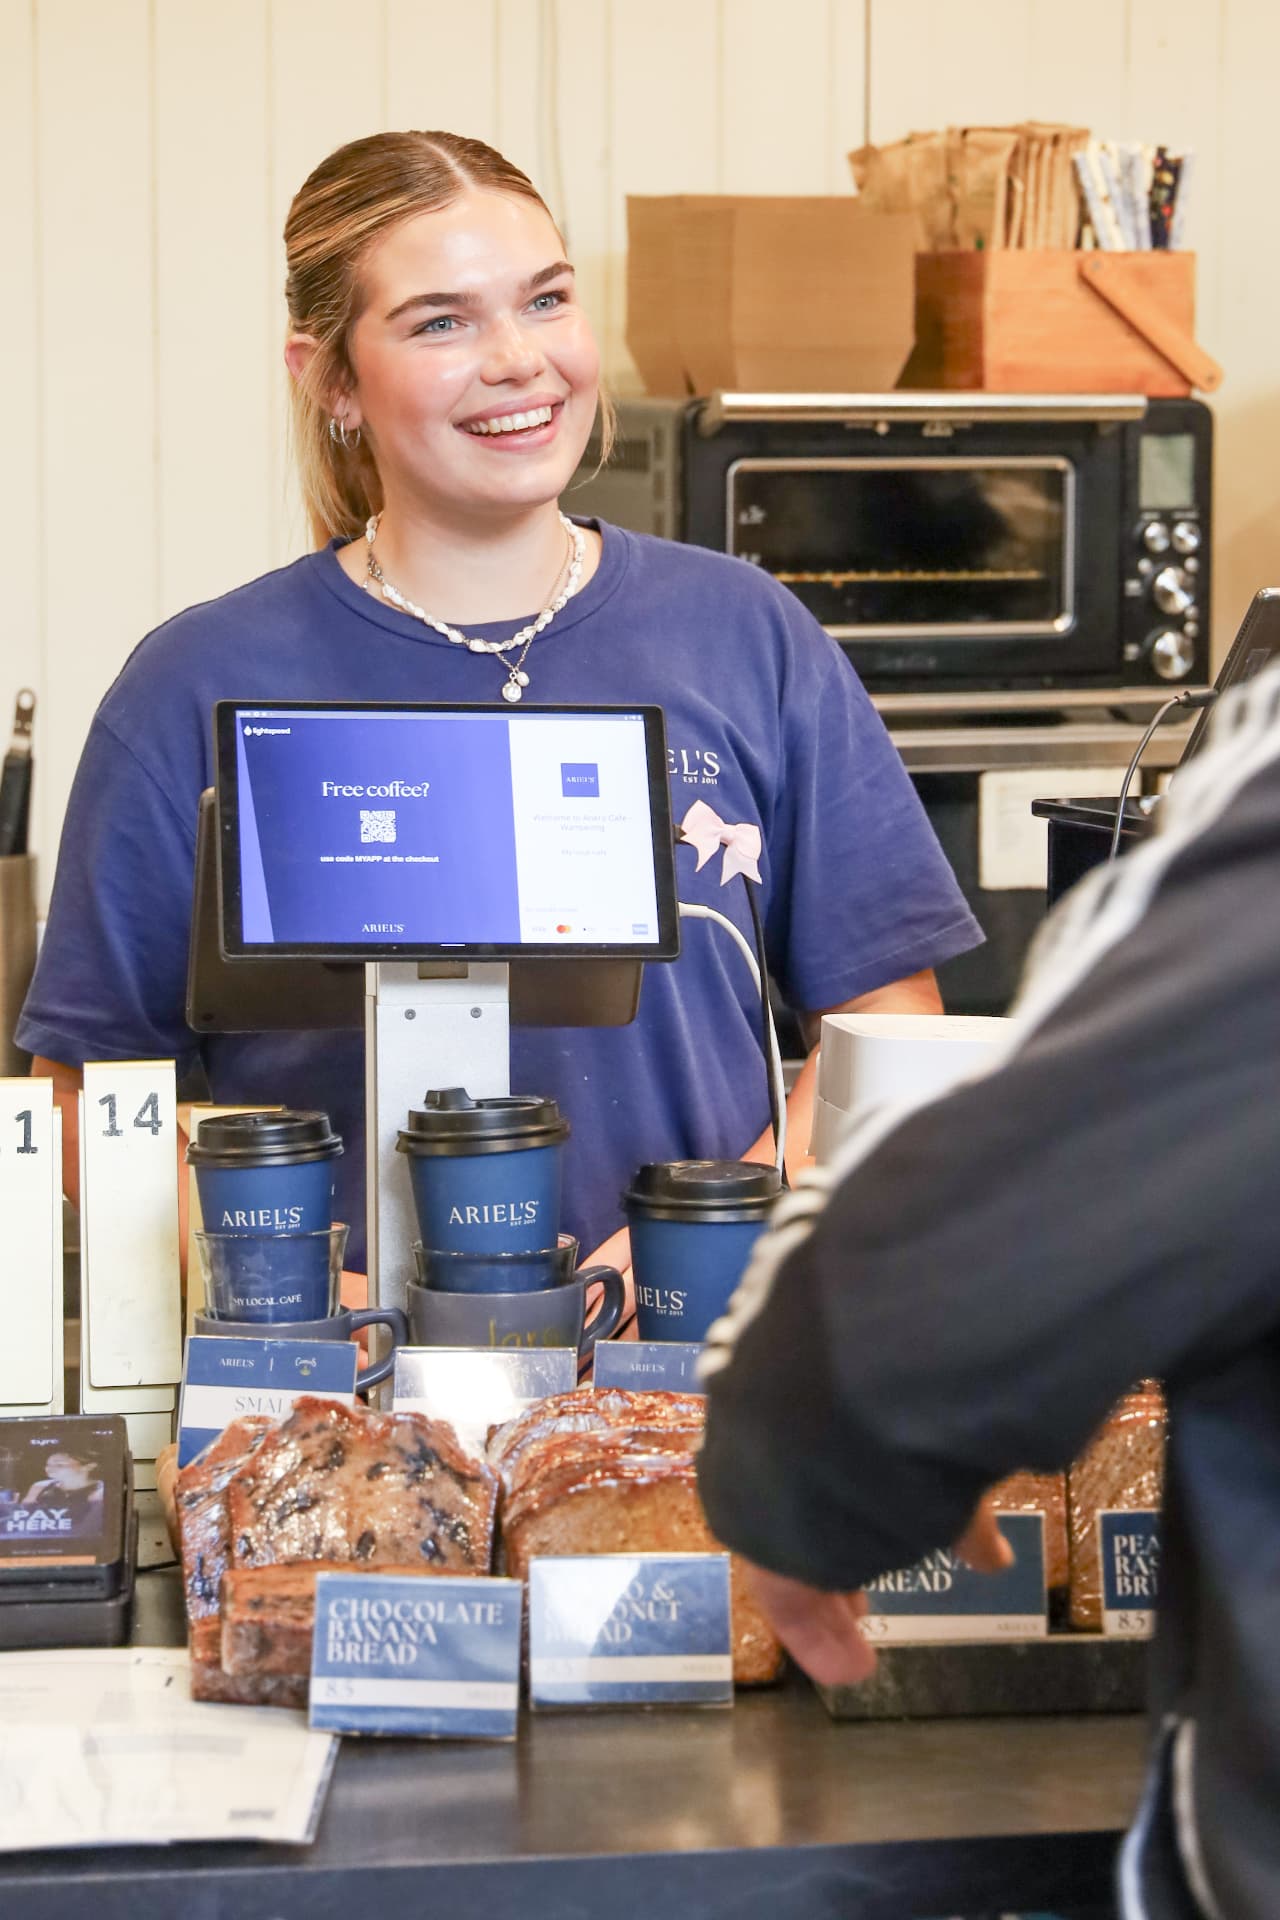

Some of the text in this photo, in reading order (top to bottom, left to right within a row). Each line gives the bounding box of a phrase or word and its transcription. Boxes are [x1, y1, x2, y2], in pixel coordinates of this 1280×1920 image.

[253, 726, 291, 737] lightspeed
[667, 748, 721, 777] EL'S
[321, 780, 430, 798] Free coffee?
[683, 776, 698, 784] EST
[335, 855, 354, 863] code
[354, 855, 383, 863] MYAPP
[391, 855, 404, 863] the
[405, 855, 440, 863] checkout
[361, 923, 405, 933] ARIEL'S
[98, 1092, 163, 1136] 14
[0, 1110, 38, 1154] 1
[221, 1206, 302, 1227] ARIEL'S
[448, 1200, 538, 1225] ARIEL'S
[246, 1296, 278, 1306] LOCAL
[637, 1285, 684, 1311] IEL'S
[219, 1357, 256, 1368] ARIEL'S
[234, 1395, 294, 1414] SMAL
[13, 1508, 70, 1521] PAY
[6, 1518, 73, 1532] HERE
[651, 1579, 676, 1601] &
[1116, 1575, 1157, 1596] BR
[328, 1598, 504, 1626] CHOCOLATE
[1118, 1610, 1146, 1630] 8.5
[326, 1619, 438, 1645] BANANA
[326, 1641, 418, 1665] BREAD
